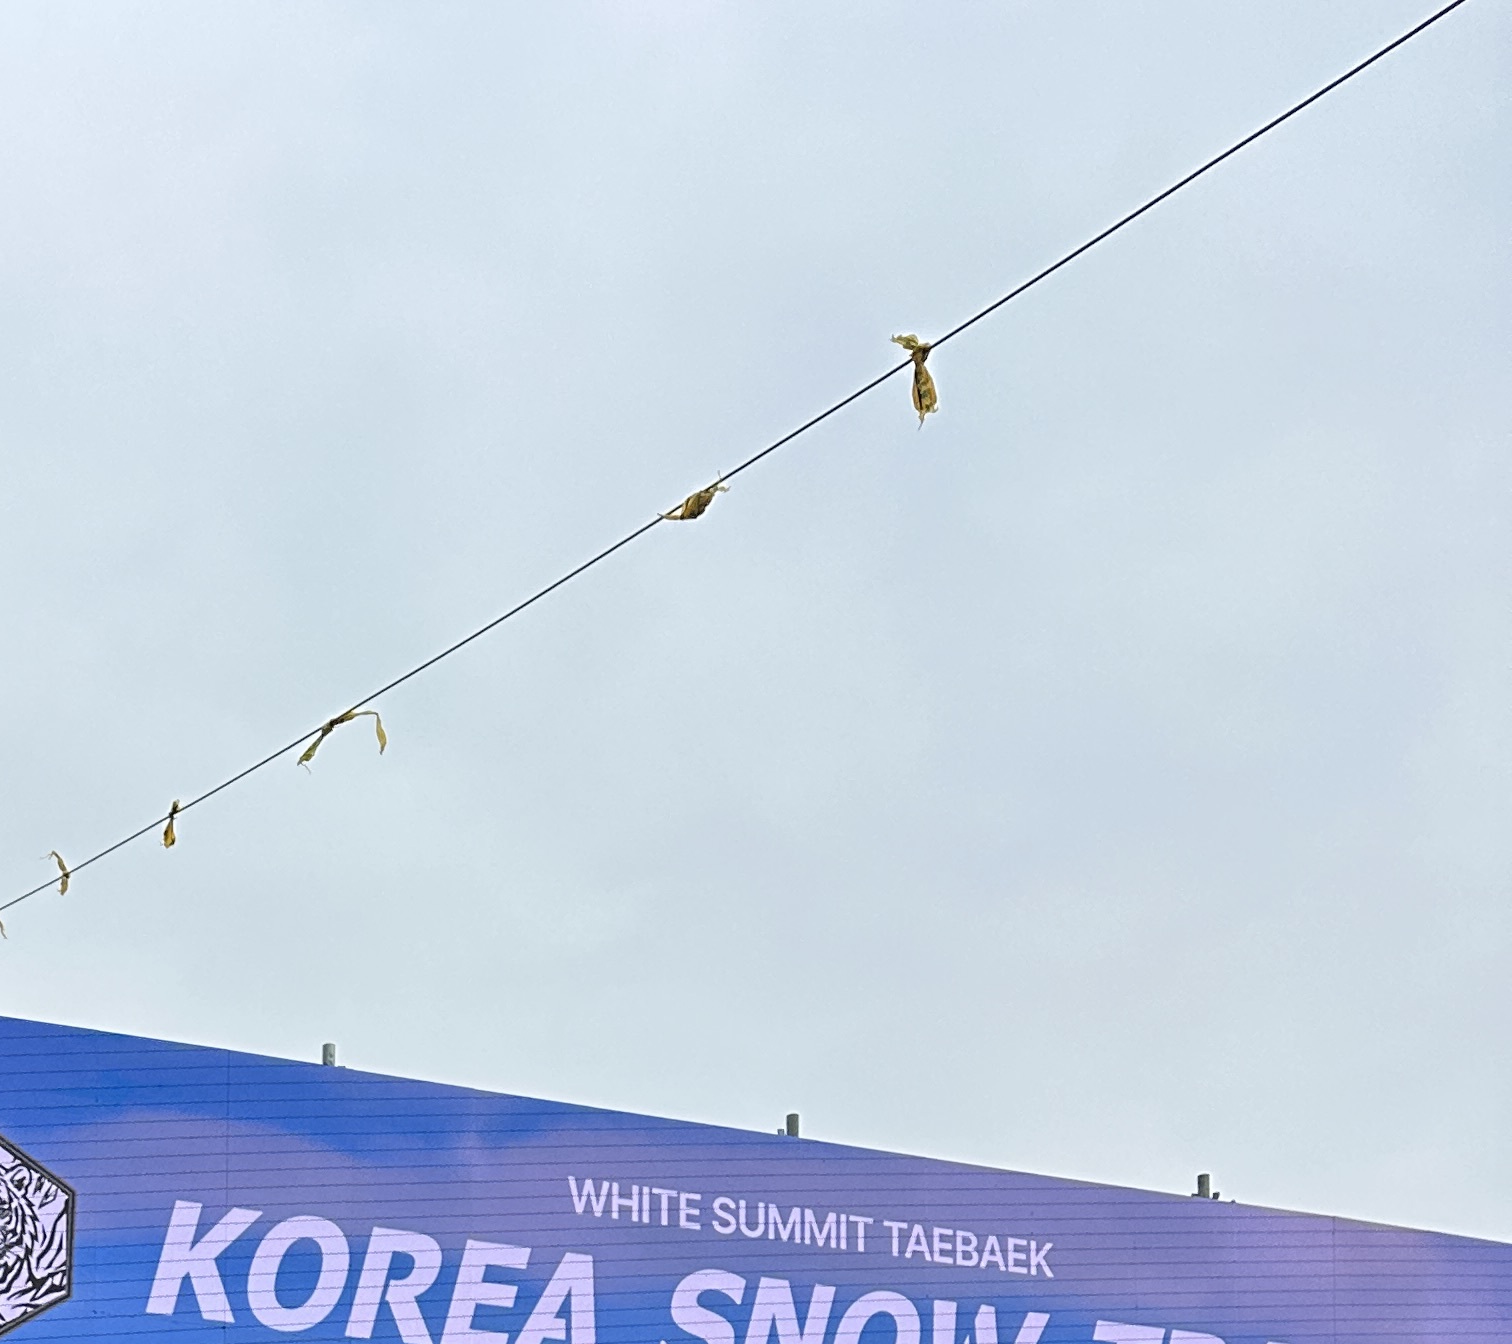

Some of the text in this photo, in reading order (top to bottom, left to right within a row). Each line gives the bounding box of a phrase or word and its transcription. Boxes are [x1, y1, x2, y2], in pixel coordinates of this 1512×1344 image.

[568, 1175, 1054, 1279] WHITE SUMMIT TAEBAEK
